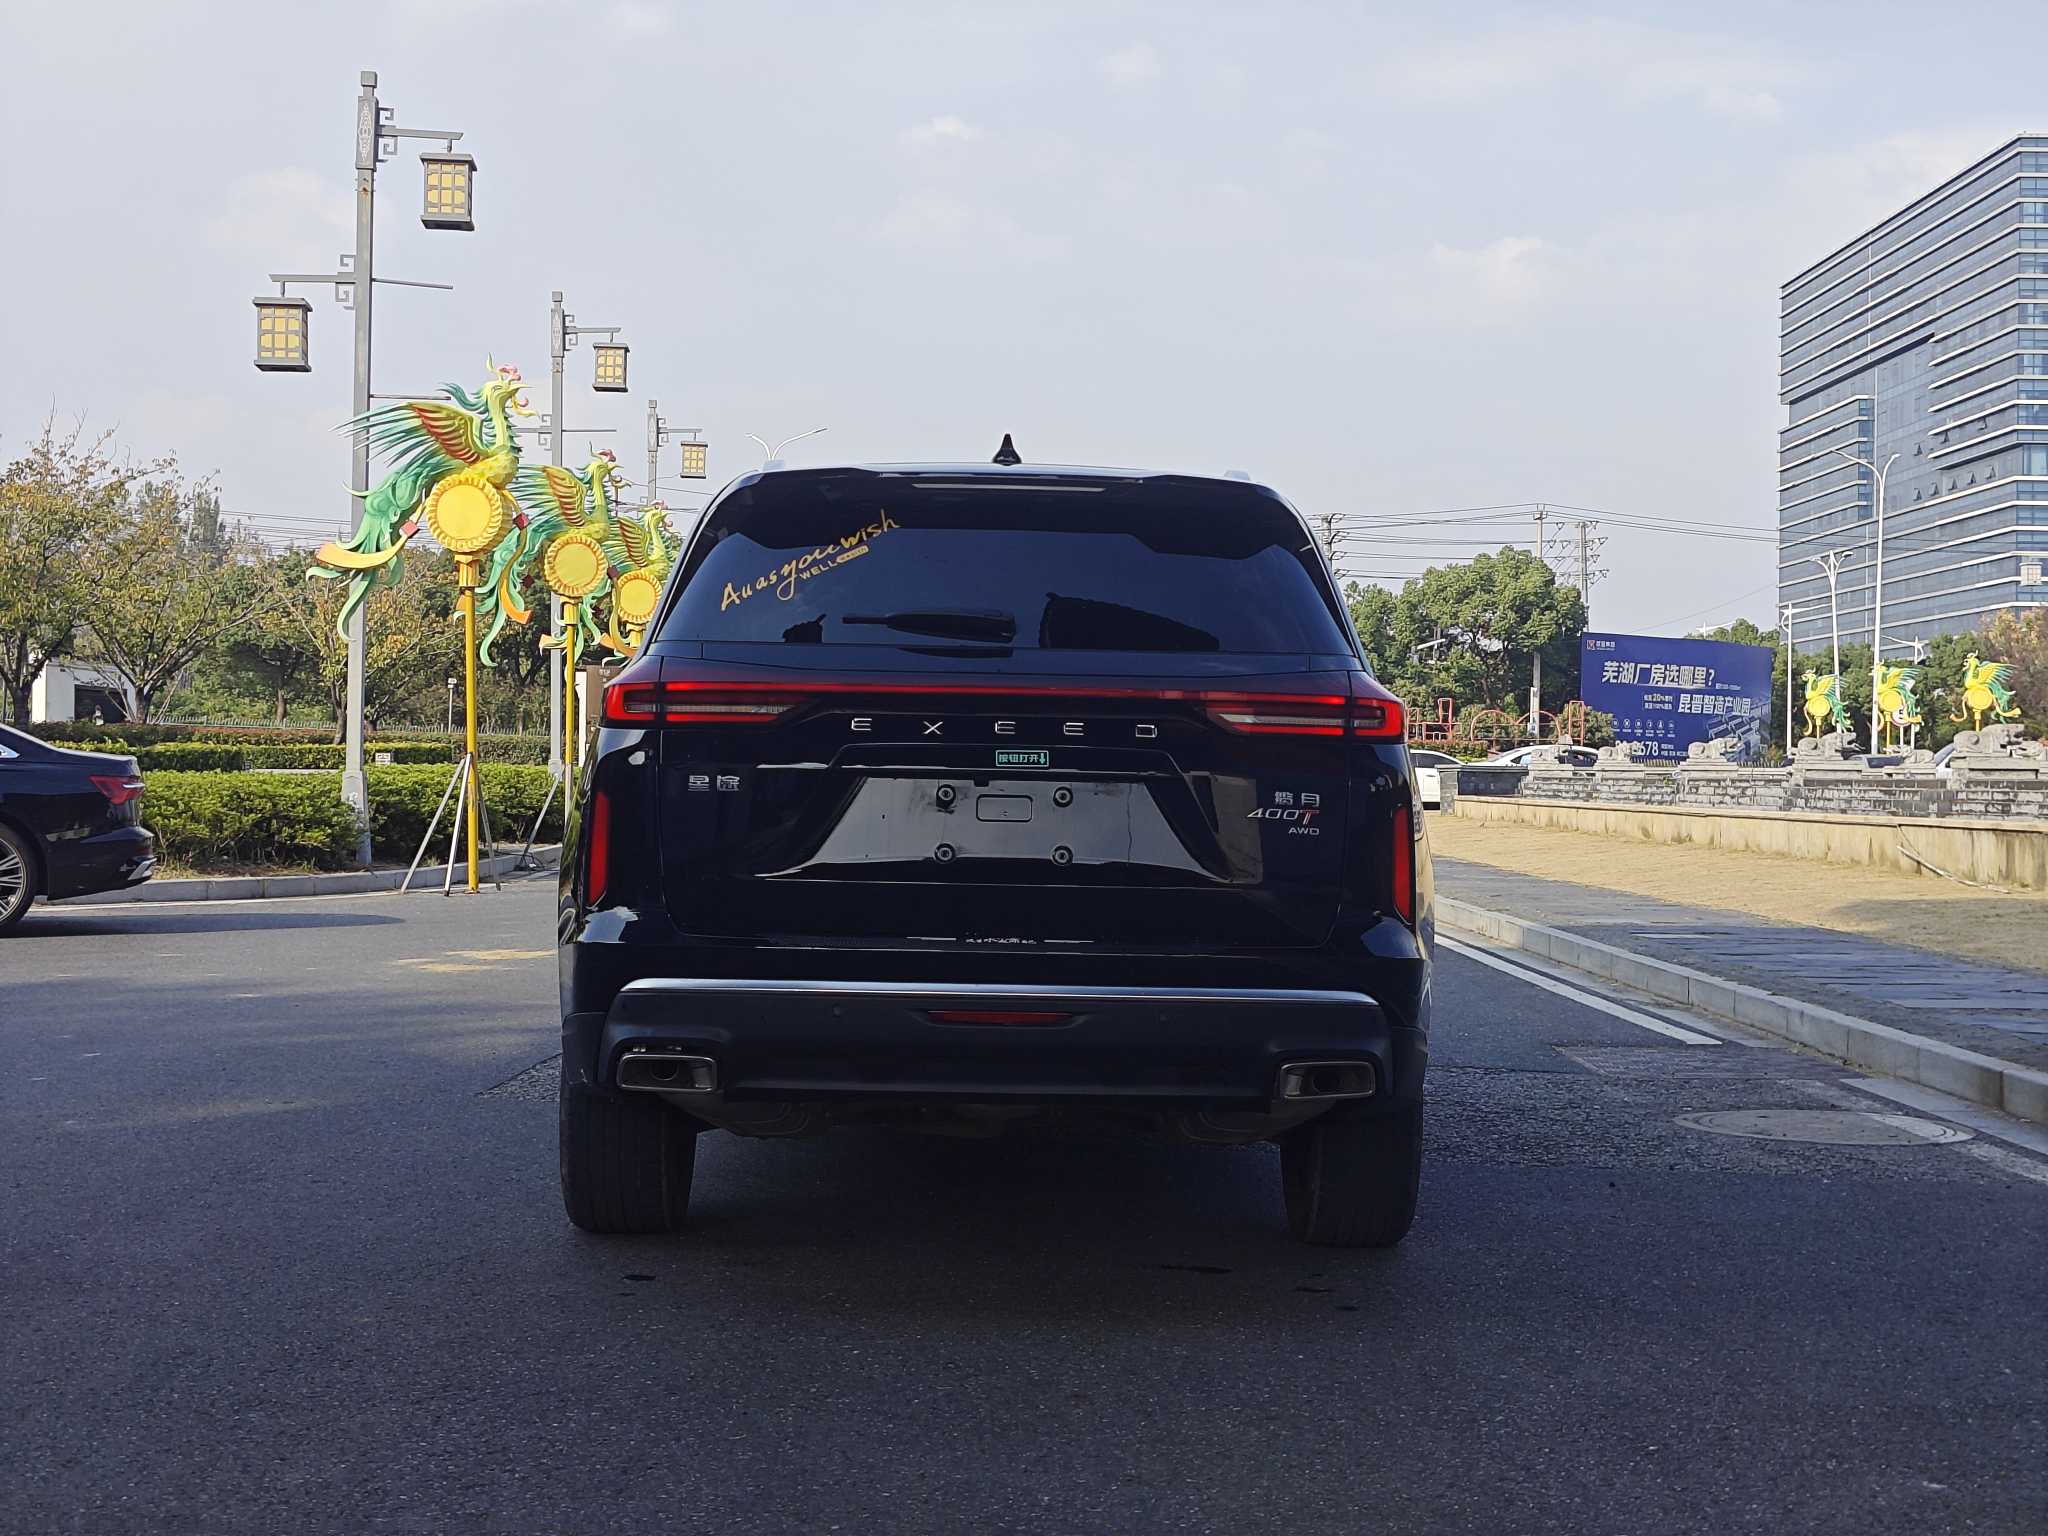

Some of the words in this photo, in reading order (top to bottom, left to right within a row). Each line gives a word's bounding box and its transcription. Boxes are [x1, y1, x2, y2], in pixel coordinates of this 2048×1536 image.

[840, 508, 901, 549] wish
[851, 718, 1158, 738] EXEED
[688, 775, 740, 791] 星途
[1247, 808, 1320, 825] 400T
[1288, 827, 1319, 835] AWD
